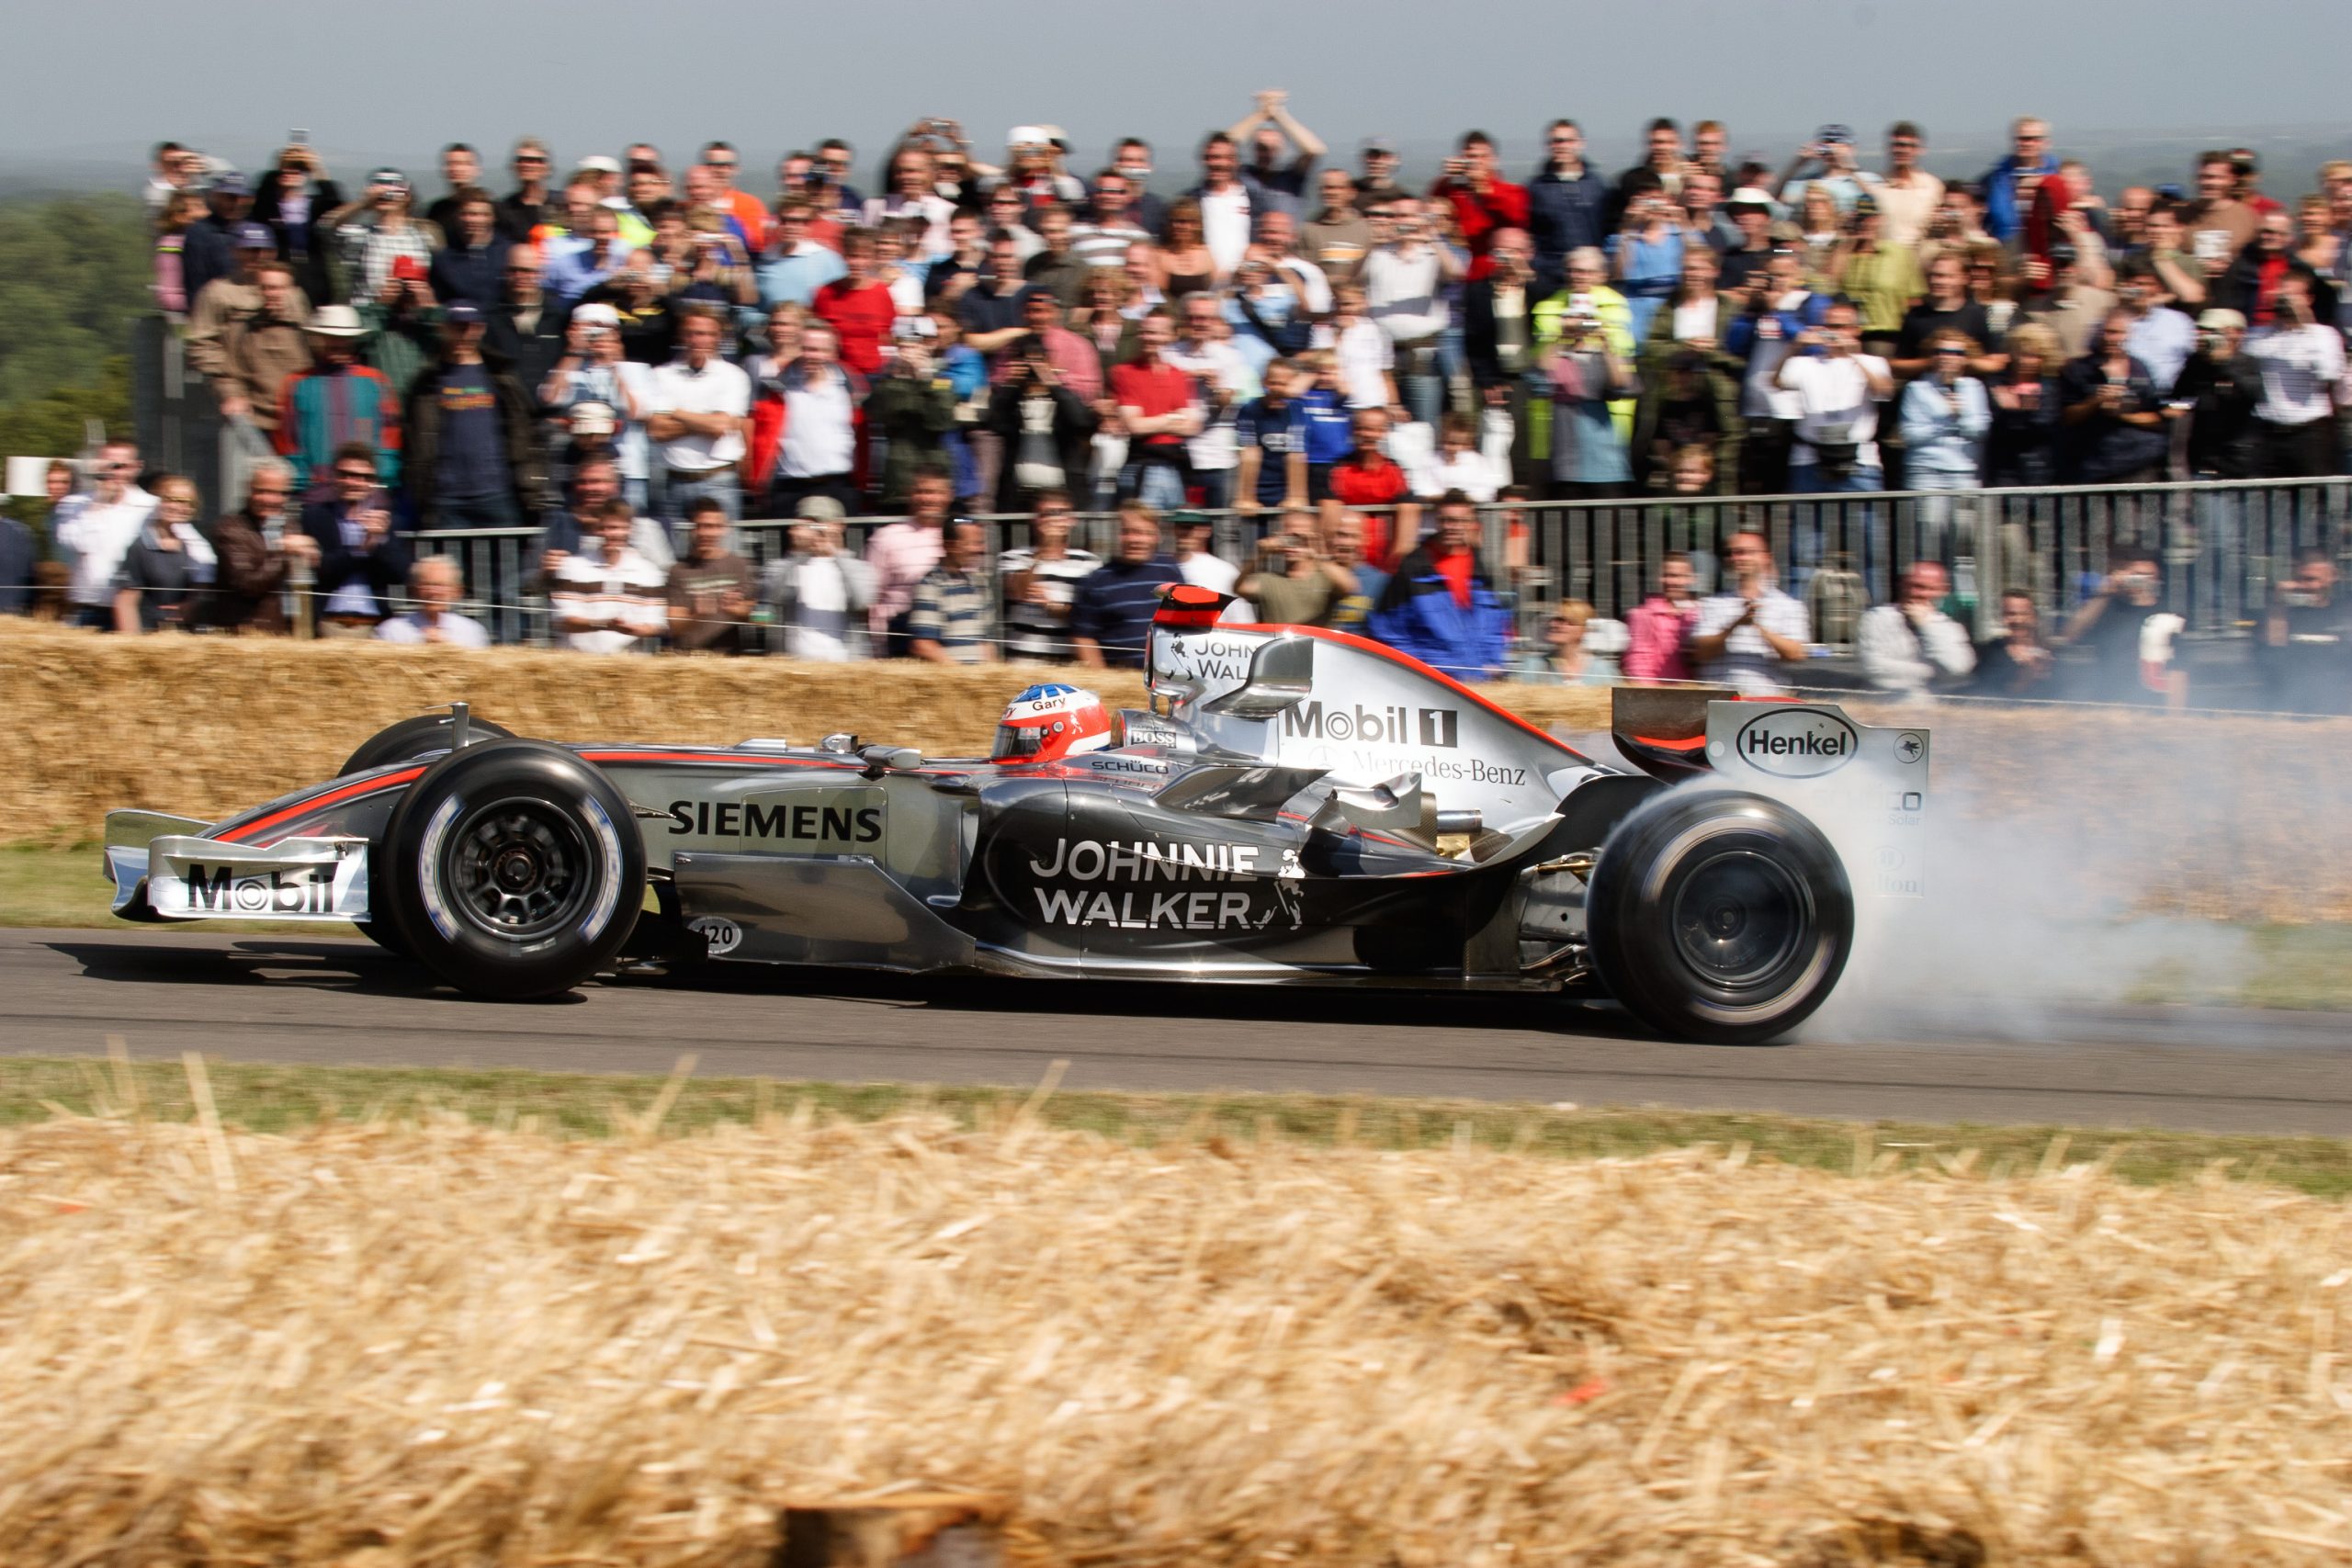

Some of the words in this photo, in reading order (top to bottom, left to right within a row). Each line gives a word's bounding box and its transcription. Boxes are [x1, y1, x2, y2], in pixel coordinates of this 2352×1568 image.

[1194, 638, 1258, 659] JOHN
[1197, 659, 1248, 681] WAL
[1032, 697, 1067, 711] Gary
[1285, 700, 1408, 745] Mobil
[1132, 731, 1176, 744] BOSS
[1748, 729, 1847, 756] Henkel
[1091, 759, 1169, 775] SCHÜCO
[1352, 750, 1526, 786] Mercedes-Benz
[668, 799, 883, 843] SIEMENS
[1888, 813, 1921, 826] Solar
[1030, 838, 1260, 882] JOHNNIE
[187, 863, 334, 912] Mobil
[1034, 886, 1251, 930] WALKER
